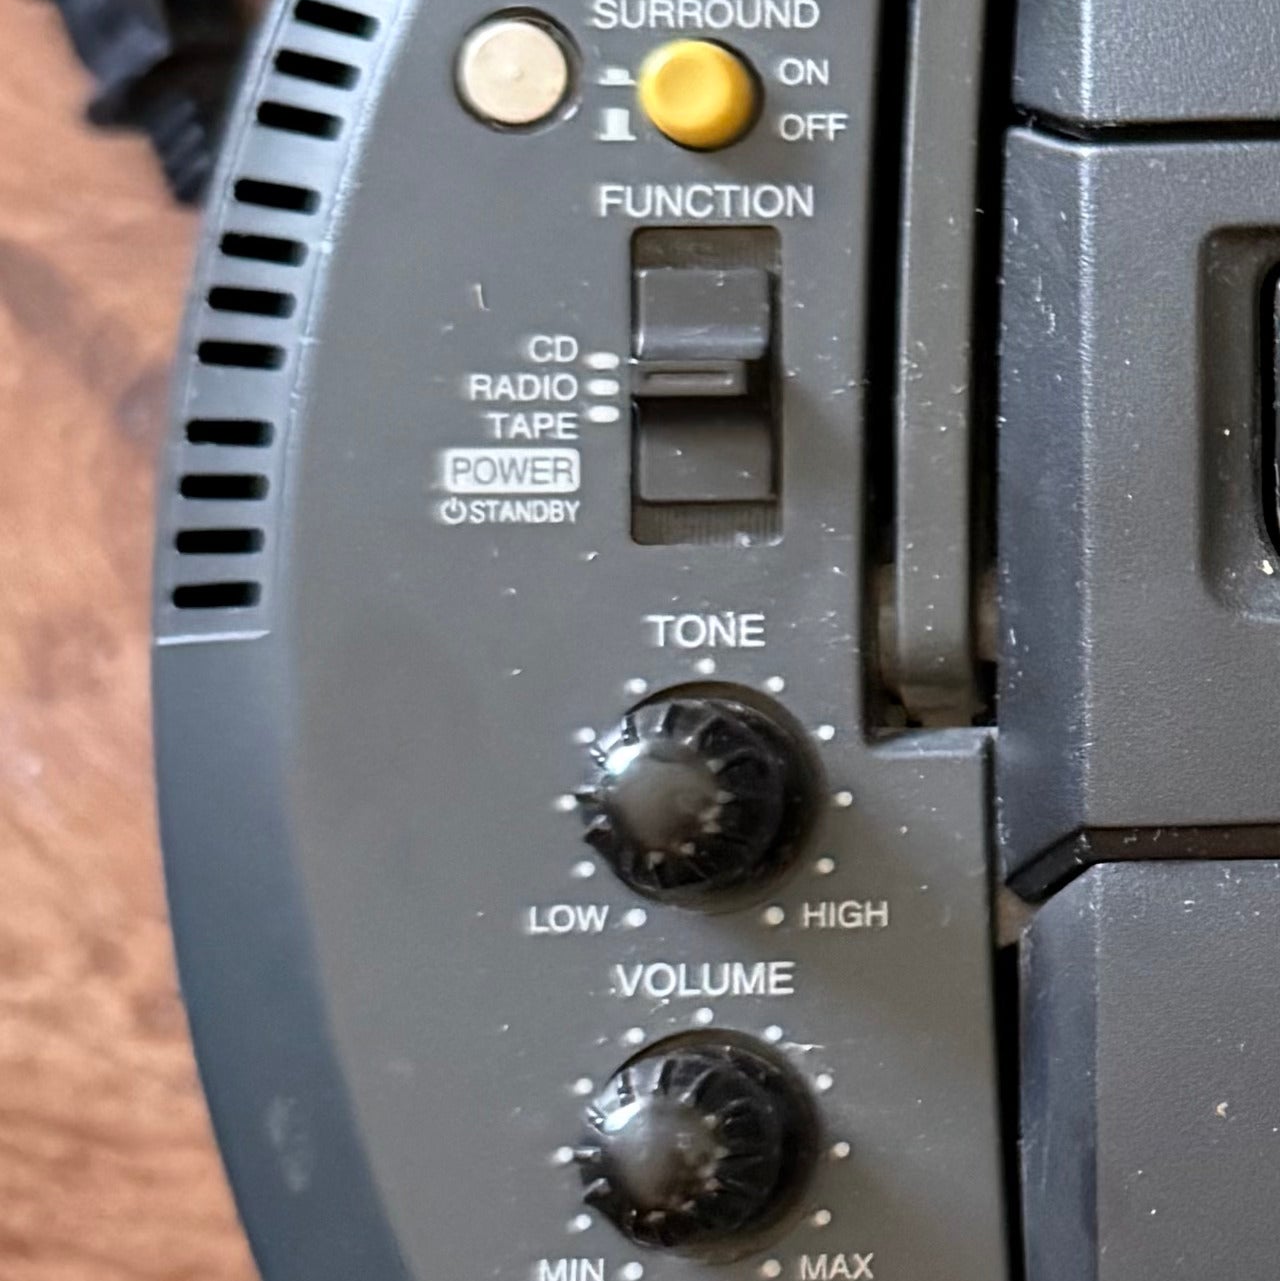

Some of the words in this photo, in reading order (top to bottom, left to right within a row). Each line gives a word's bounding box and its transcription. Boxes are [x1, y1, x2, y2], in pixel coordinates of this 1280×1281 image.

[779, 58, 829, 86] ON
[779, 113, 849, 142] OFF
[598, 184, 815, 218] FUNCTION
[526, 335, 579, 363] CD
[468, 373, 579, 401] RADIO
[488, 414, 580, 440] TAPE
[450, 457, 575, 485] POWER
[468, 500, 580, 523] STANDBY
[648, 614, 766, 648] TONE
[524, 904, 610, 934] LOW
[801, 901, 890, 929] HIGH
[616, 961, 796, 996] VOLUME
[799, 1253, 875, 1281] MAX
